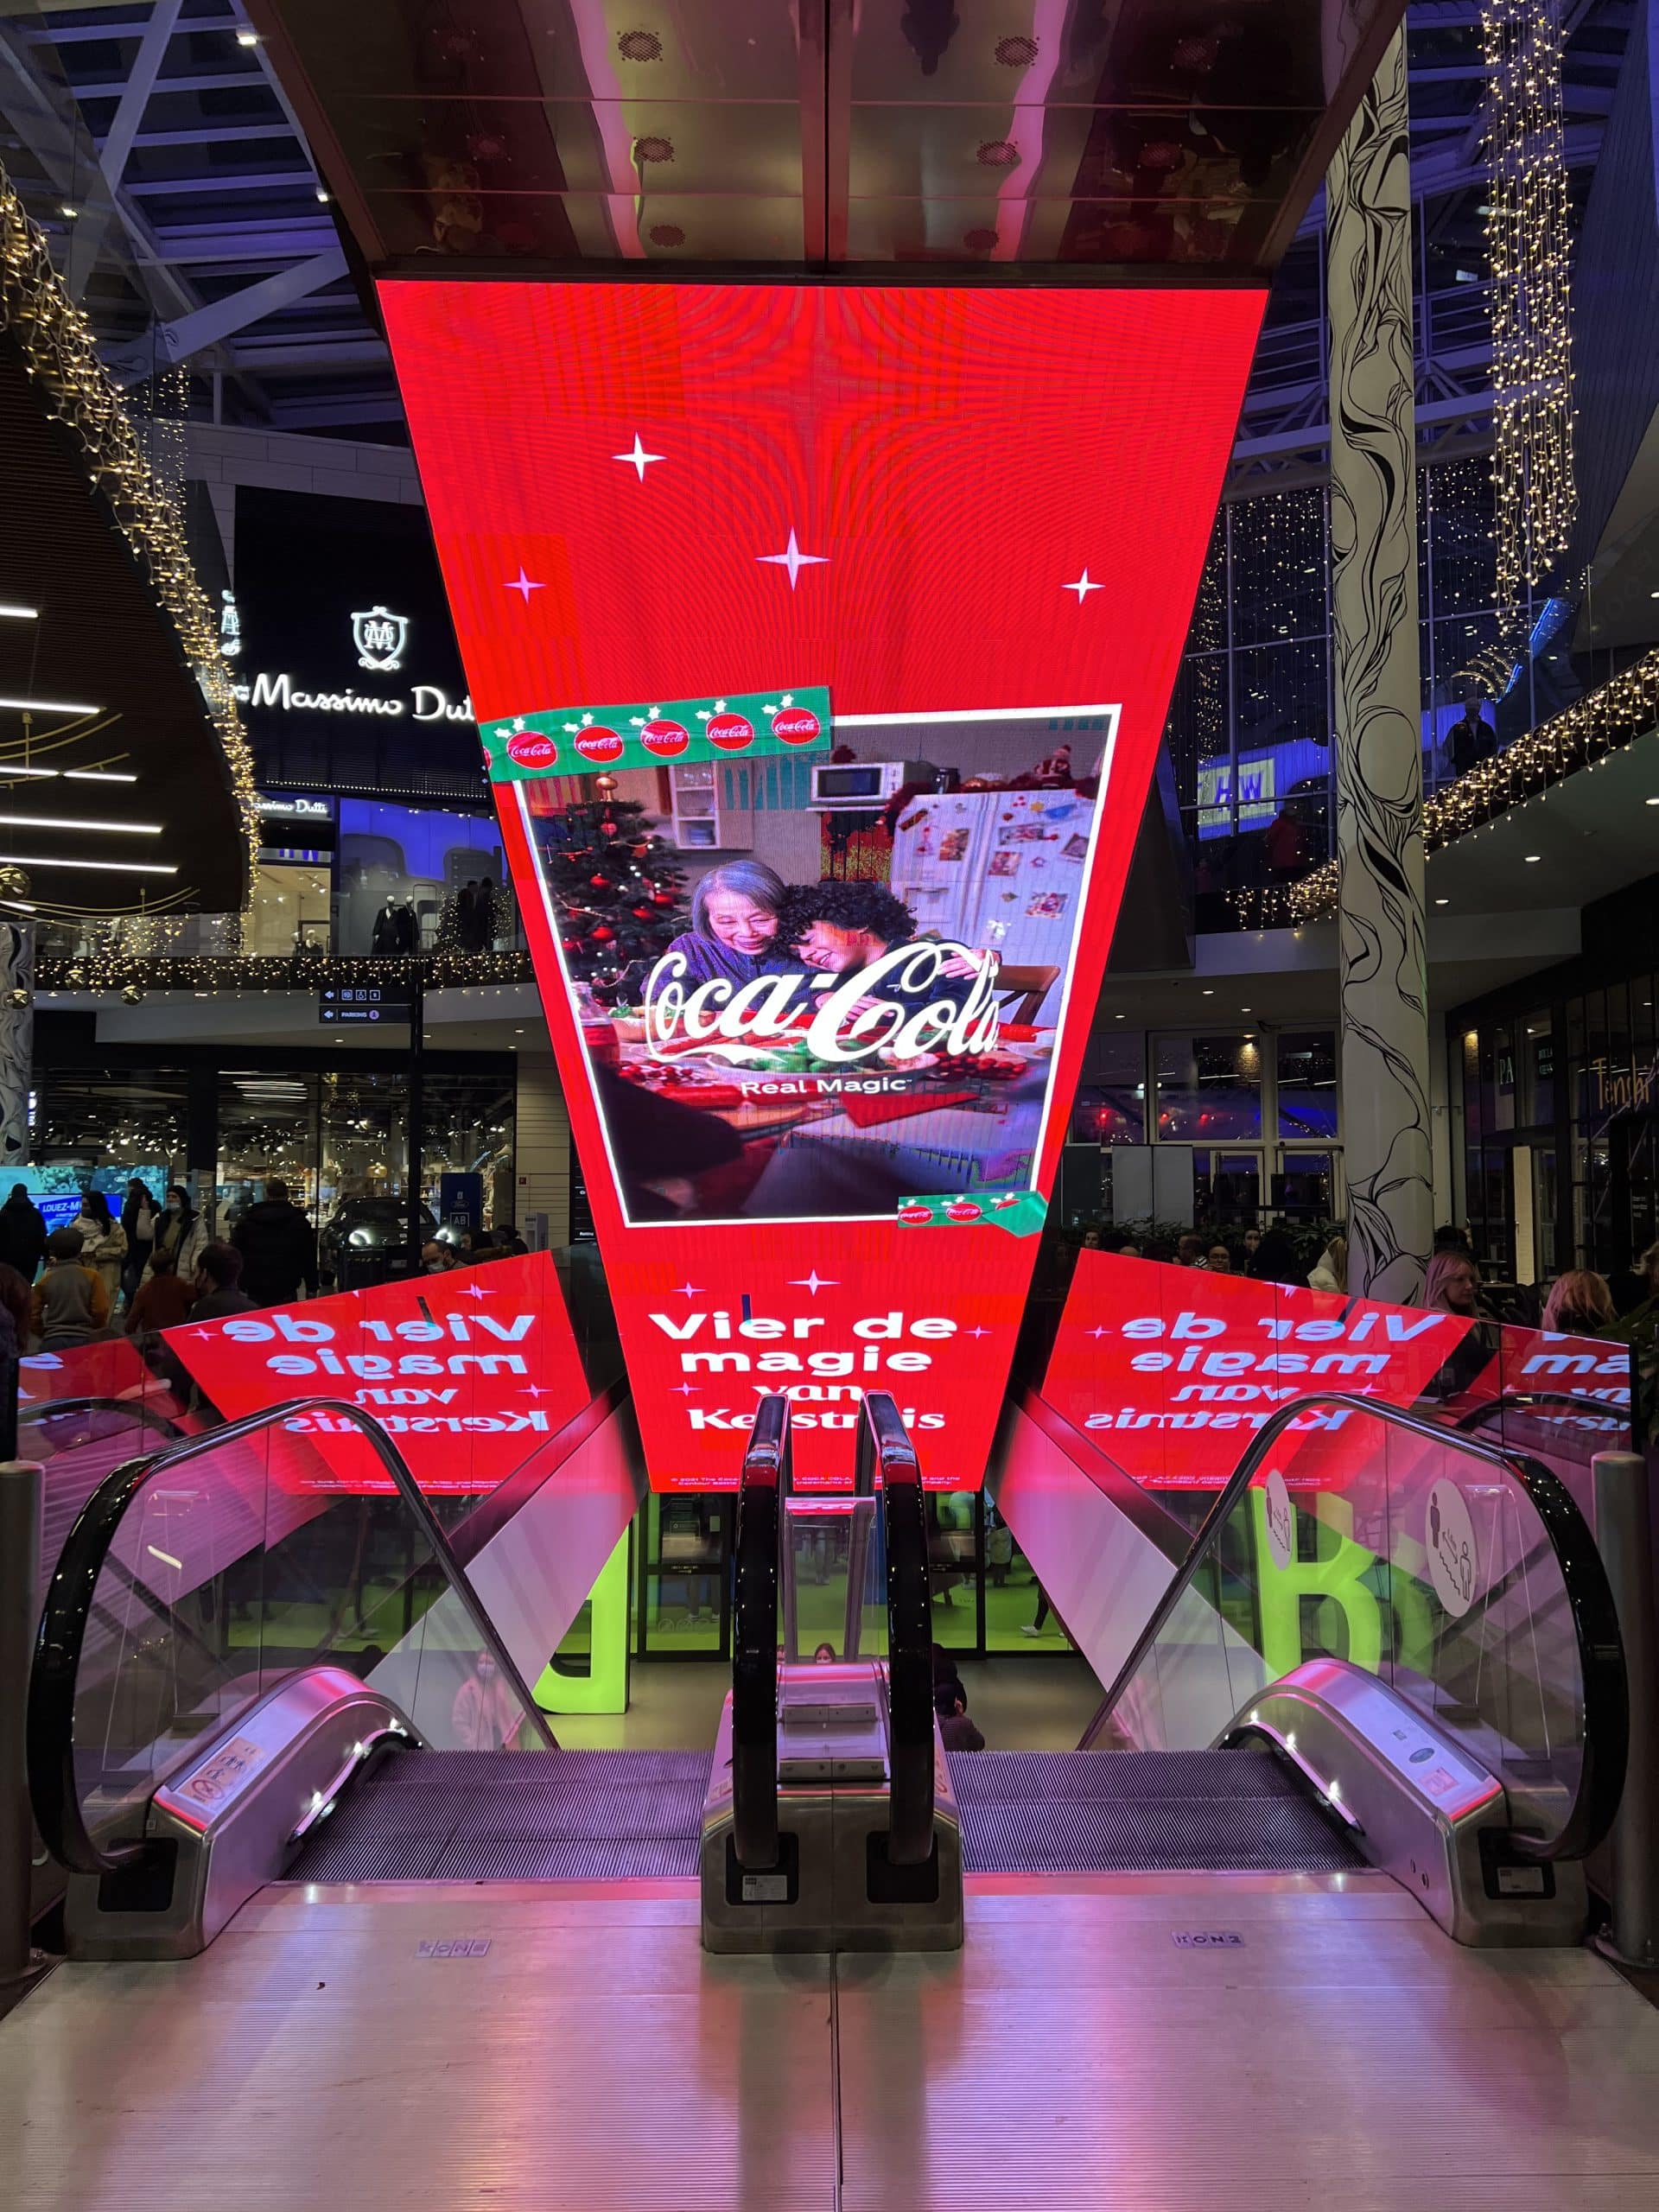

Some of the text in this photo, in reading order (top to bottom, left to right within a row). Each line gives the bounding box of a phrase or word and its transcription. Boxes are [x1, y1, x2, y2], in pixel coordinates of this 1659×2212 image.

[252, 673, 403, 715] Massimo
[411, 686, 474, 721] Dut
[295, 798, 328, 814] Dutti
[644, 942, 999, 1064] Coca-Cola
[741, 1079, 807, 1095] Real
[42, 1202, 83, 1212] LOUEZ-M
[648, 1312, 958, 1339] Vier de
[681, 1346, 933, 1376] magie
[687, 1408, 945, 1430] Kestis
